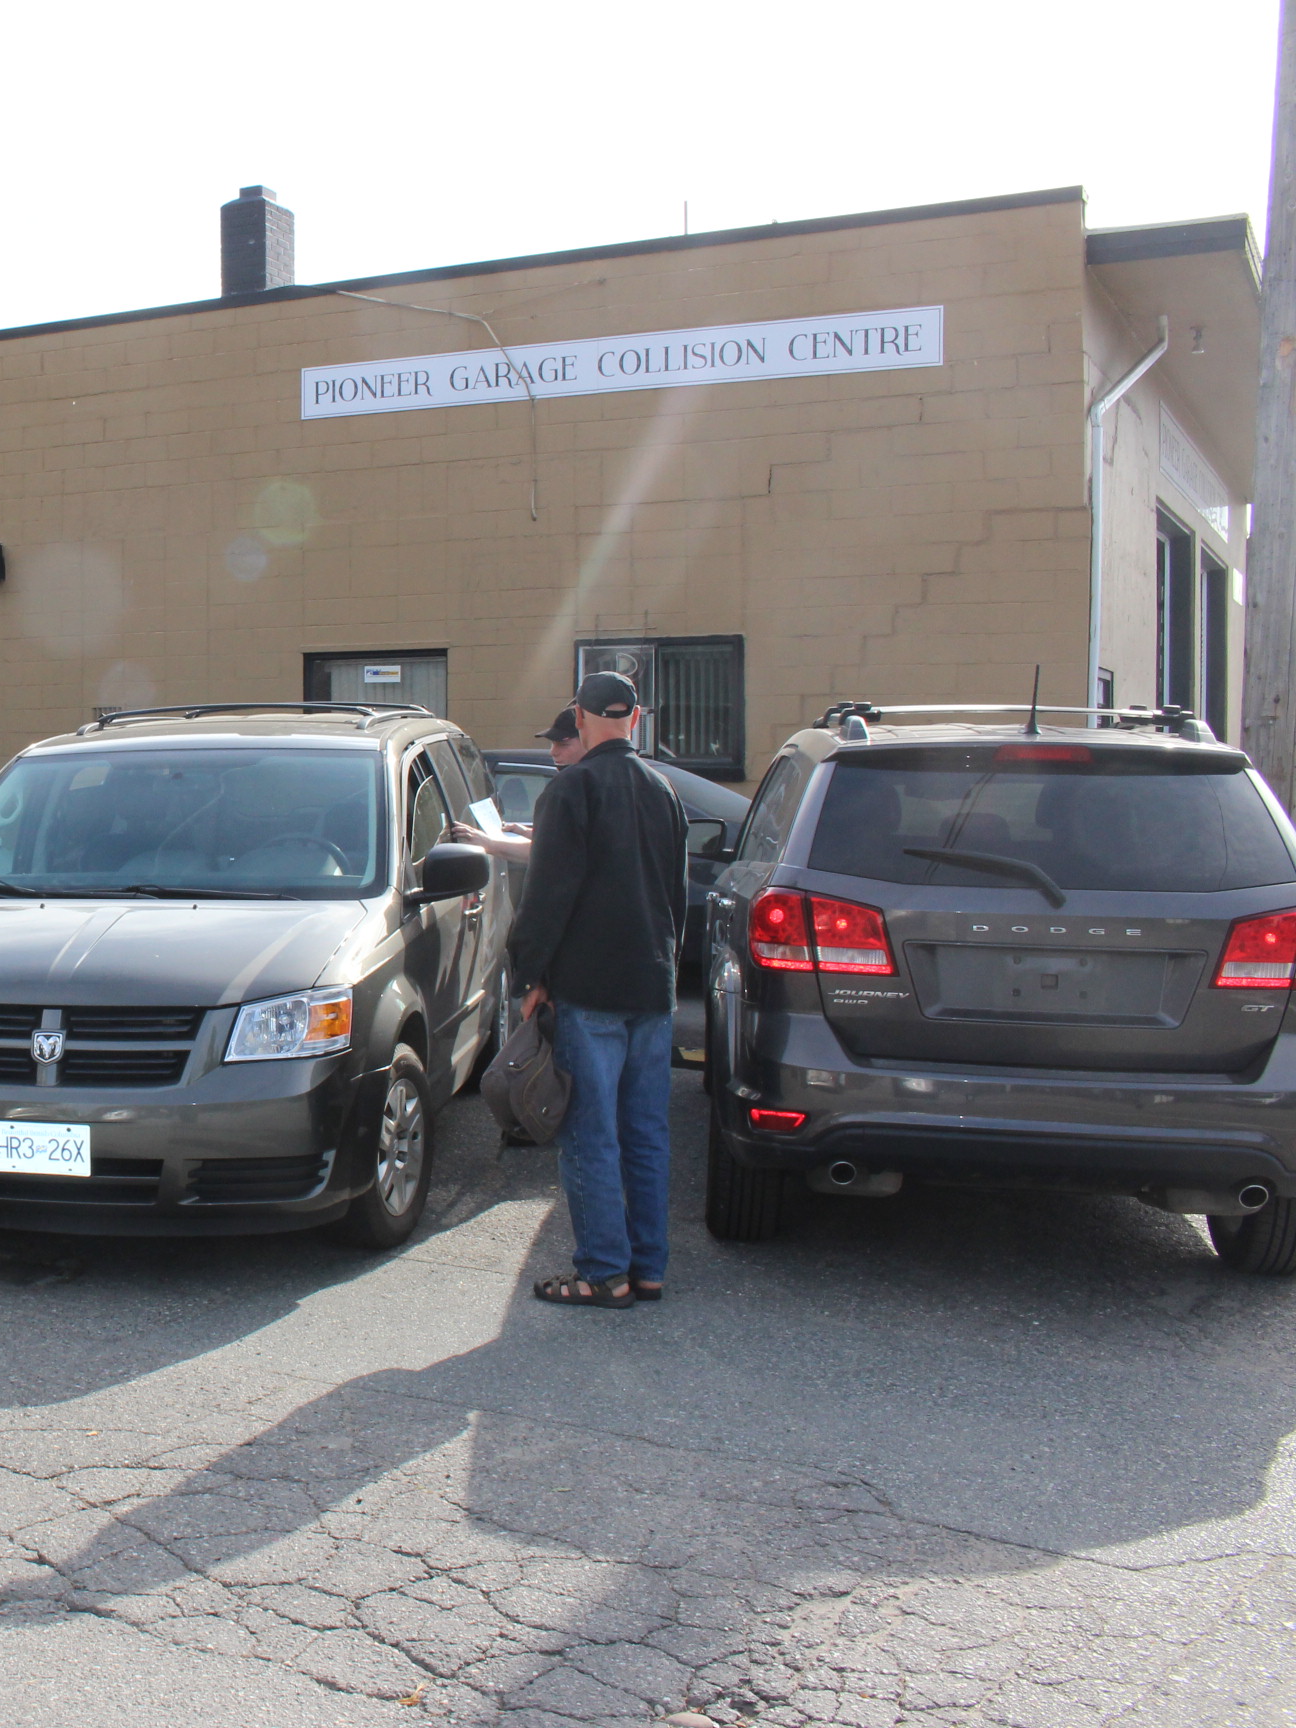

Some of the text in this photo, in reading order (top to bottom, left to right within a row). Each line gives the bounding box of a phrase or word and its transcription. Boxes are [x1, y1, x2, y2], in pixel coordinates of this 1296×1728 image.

[314, 323, 924, 405] PIONEER GARAGE COLLISION CENTRE
[972, 924, 1142, 936] DODGE
[827, 989, 910, 999] JOURNEY
[1240, 1004, 1275, 1012] GT
[48, 1138, 85, 1163] 26X
